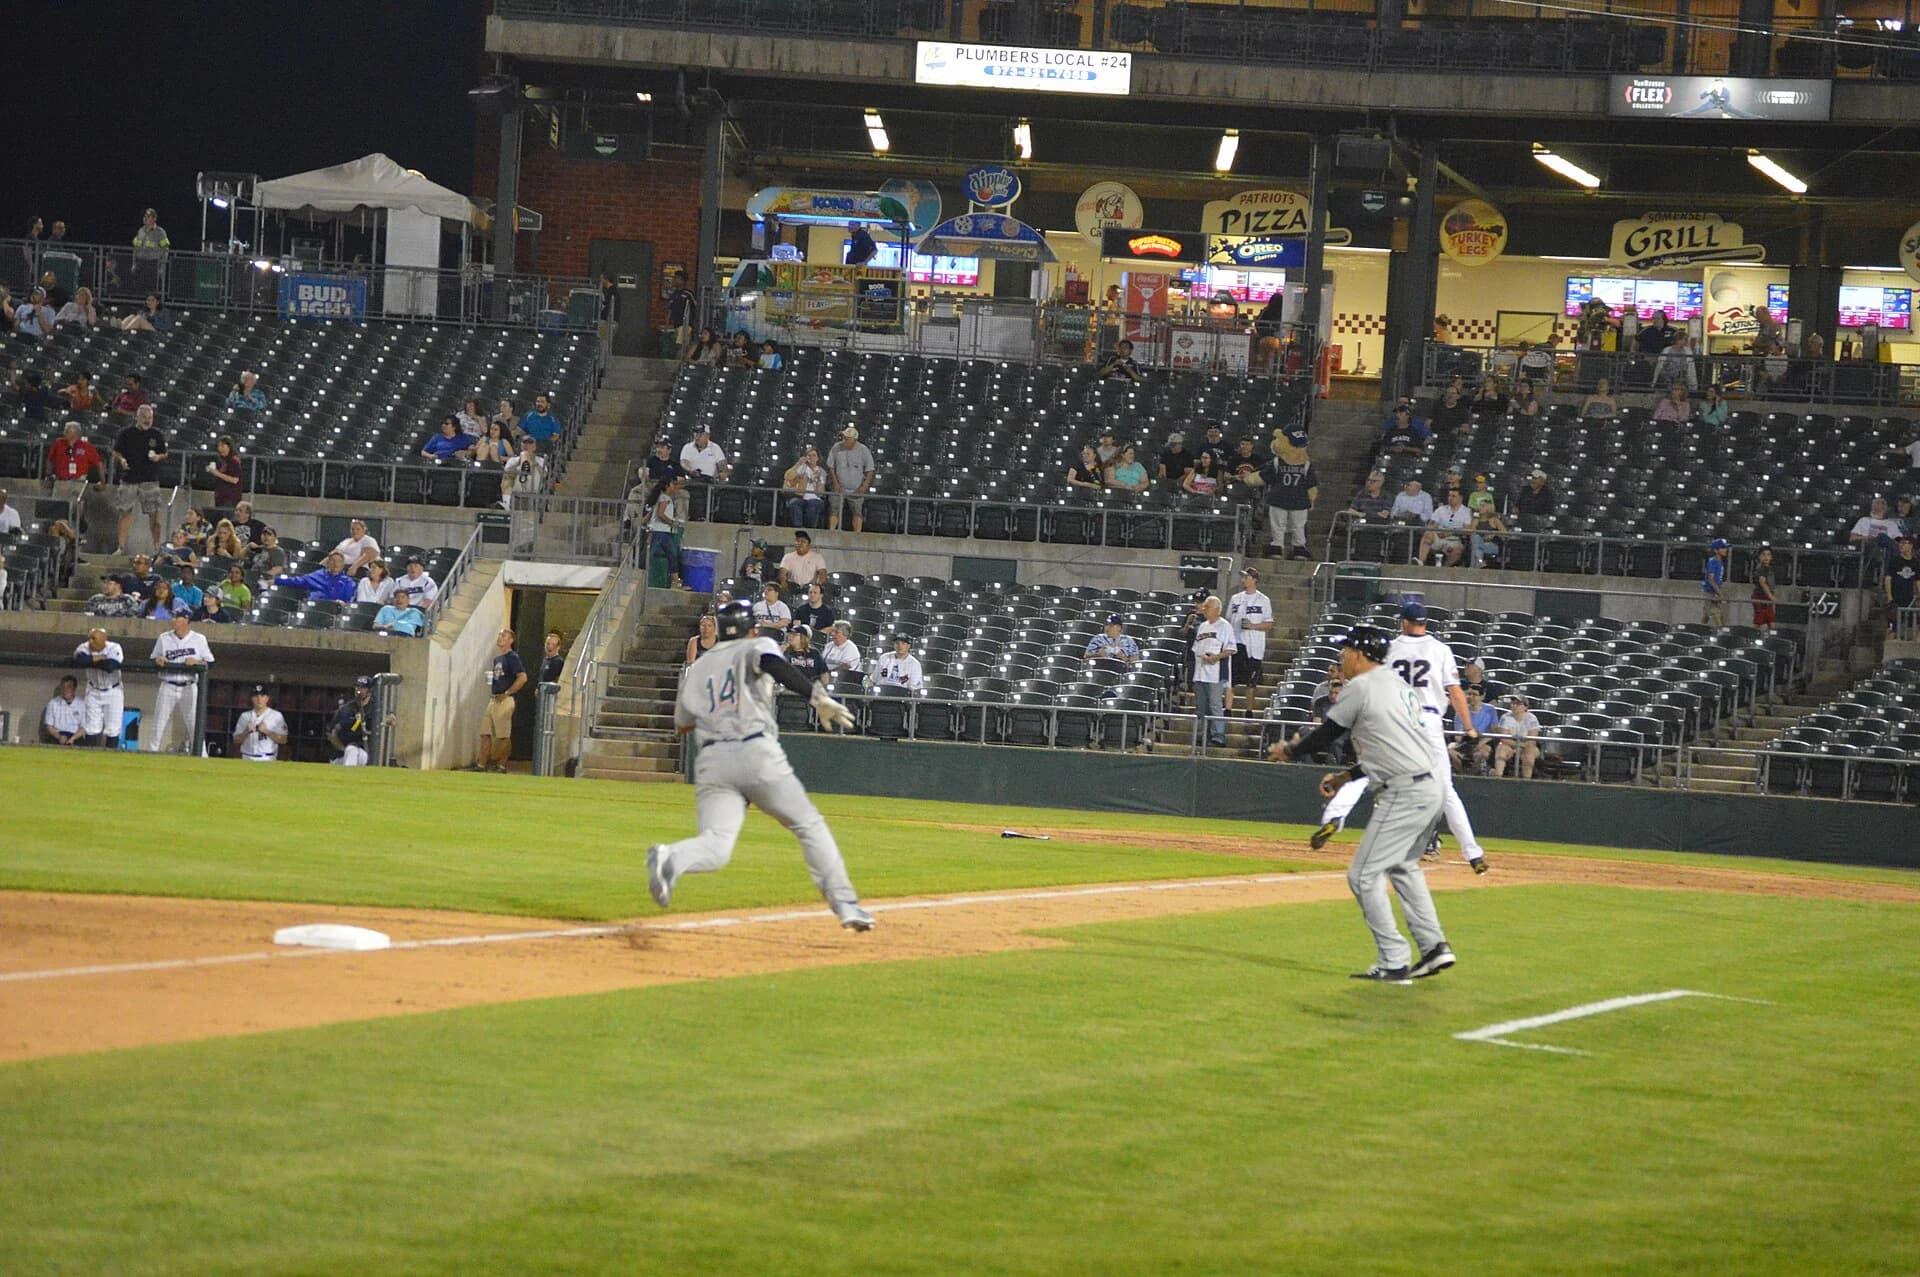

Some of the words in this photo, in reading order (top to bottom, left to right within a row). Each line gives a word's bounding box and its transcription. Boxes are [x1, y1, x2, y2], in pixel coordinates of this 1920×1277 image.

[956, 47, 1040, 64] PLUMBERS
[1045, 53, 1095, 66] LOCAL
[1100, 56, 1128, 69] #24
[1632, 87, 1664, 103] FLEX
[1239, 192, 1295, 206] PATRIOTS
[1219, 207, 1308, 233] PIZZA
[1450, 231, 1498, 247] TURKEY
[1624, 224, 1720, 257] GRILL
[1239, 243, 1284, 257] OREO
[1458, 245, 1488, 256] LEGS
[298, 284, 347, 302] BUD
[1283, 473, 1301, 486] 07
[1392, 659, 1431, 688] 32
[706, 668, 736, 713] 14
